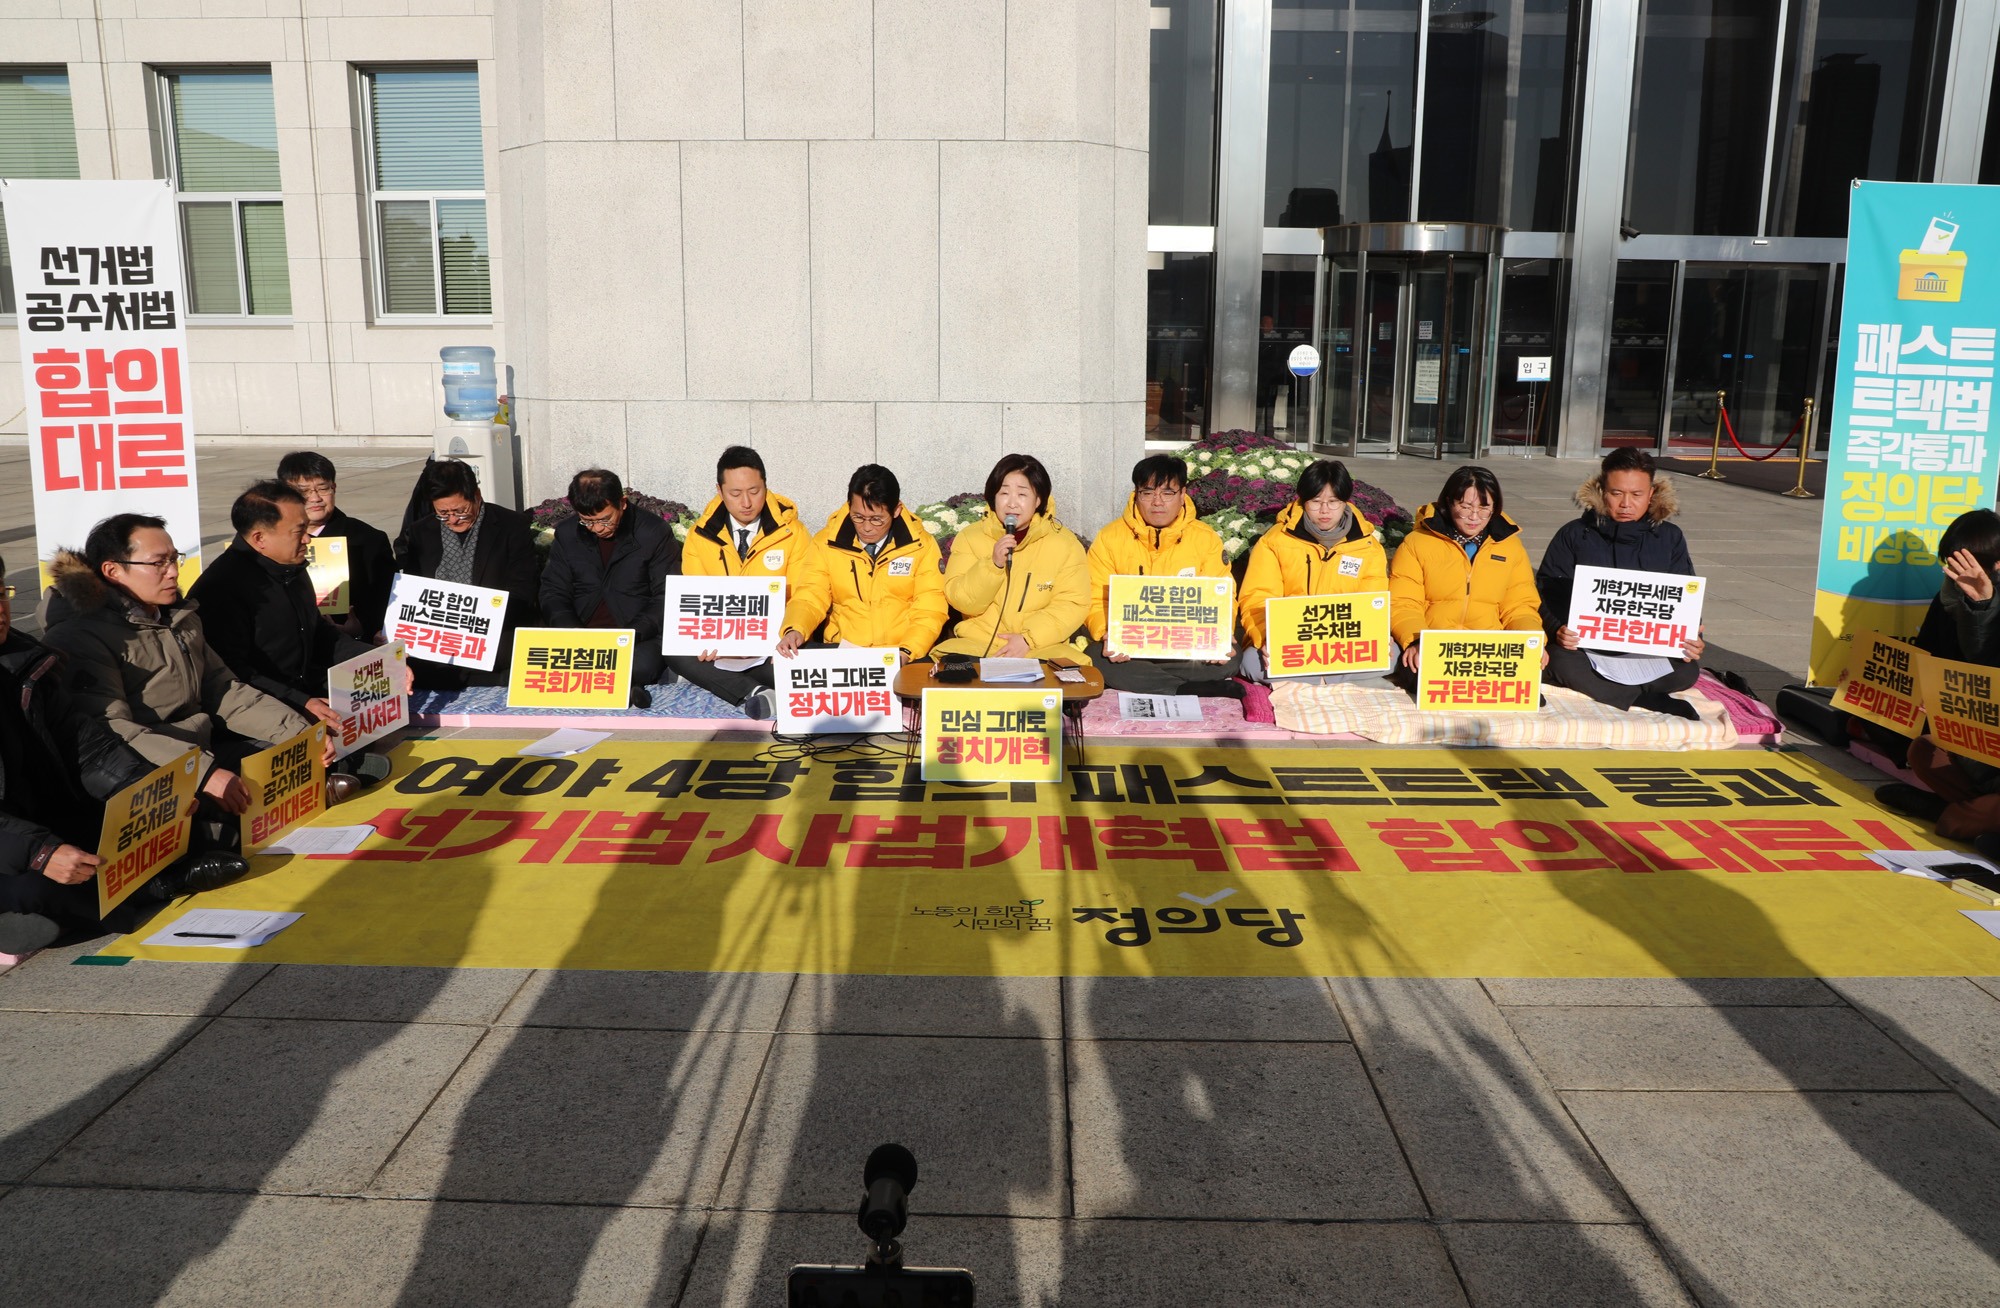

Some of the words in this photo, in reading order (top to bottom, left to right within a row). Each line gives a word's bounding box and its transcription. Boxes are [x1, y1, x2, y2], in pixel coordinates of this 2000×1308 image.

[41, 246, 154, 286] 선거법
[26, 290, 176, 332] 공수처법
[1854, 323, 1997, 378] 패스트
[33, 347, 183, 418] 합의
[1849, 377, 1993, 432] 트랙법
[40, 422, 189, 491] 대로
[1846, 429, 1987, 474] 즉각통과
[1840, 471, 1983, 526] 정의당
[1837, 526, 1949, 566] 비상행
[891, 561, 911, 571] 정의당
[1341, 560, 1360, 572] 정의당
[417, 589, 445, 608] 4당
[446, 591, 479, 615] 합의
[679, 593, 770, 617] 특권철폐
[1139, 585, 1166, 604] 4당
[1169, 585, 1202, 605] 합의
[1595, 597, 1675, 620] 자유한국당
[398, 604, 491, 636] 패스트트랙법
[1122, 604, 1219, 625] 패스트트랙법
[1302, 602, 1352, 623] 선거법
[393, 624, 487, 662] 즉각통과
[677, 617, 769, 641] 국회개혁
[1121, 624, 1219, 651] 즉각통과
[1297, 621, 1362, 642] 공수처법
[1576, 614, 1687, 649] 규탄한다!
[526, 647, 618, 671] 특권철폐
[1281, 639, 1379, 668] 동시처리
[1443, 661, 1518, 678] 자유한국당
[1872, 641, 1910, 672] 선거법
[353, 658, 384, 690] 선거법
[524, 670, 616, 694] 국회개혁
[790, 668, 828, 689] 민심
[831, 667, 887, 688] 그대로
[1863, 660, 1914, 697] 공수처법
[1943, 668, 1991, 700] 선거법
[350, 677, 391, 712] 공수처법
[788, 690, 892, 718] 정치개혁
[1427, 679, 1531, 705] 규탄한다!
[1843, 680, 1920, 728] 합의대로!
[342, 694, 402, 747] 동시처리
[940, 710, 981, 733] 민심
[985, 710, 1047, 733] 그대로
[1939, 690, 2000, 727] 공수처법
[271, 738, 309, 778] 선거법
[936, 736, 1051, 765] 정치개혁
[129, 770, 174, 820] 선거법
[263, 768, 312, 806] 공수처법
[394, 756, 624, 798] 여야
[625, 759, 811, 801] 4당
[1067, 764, 1609, 808] 패스트트랙
[1593, 767, 1842, 808] 통과
[117, 795, 179, 852] 공수처법
[251, 782, 320, 846] 합의대로!
[104, 820, 183, 900] 합의대로!
[1367, 818, 1916, 873] 합의대로!
[910, 904, 977, 918] 노동의
[984, 904, 1035, 919] 희망
[952, 918, 1020, 931] 시민의
[1025, 918, 1053, 932] 꿈
[1071, 906, 1306, 948] 정의당
